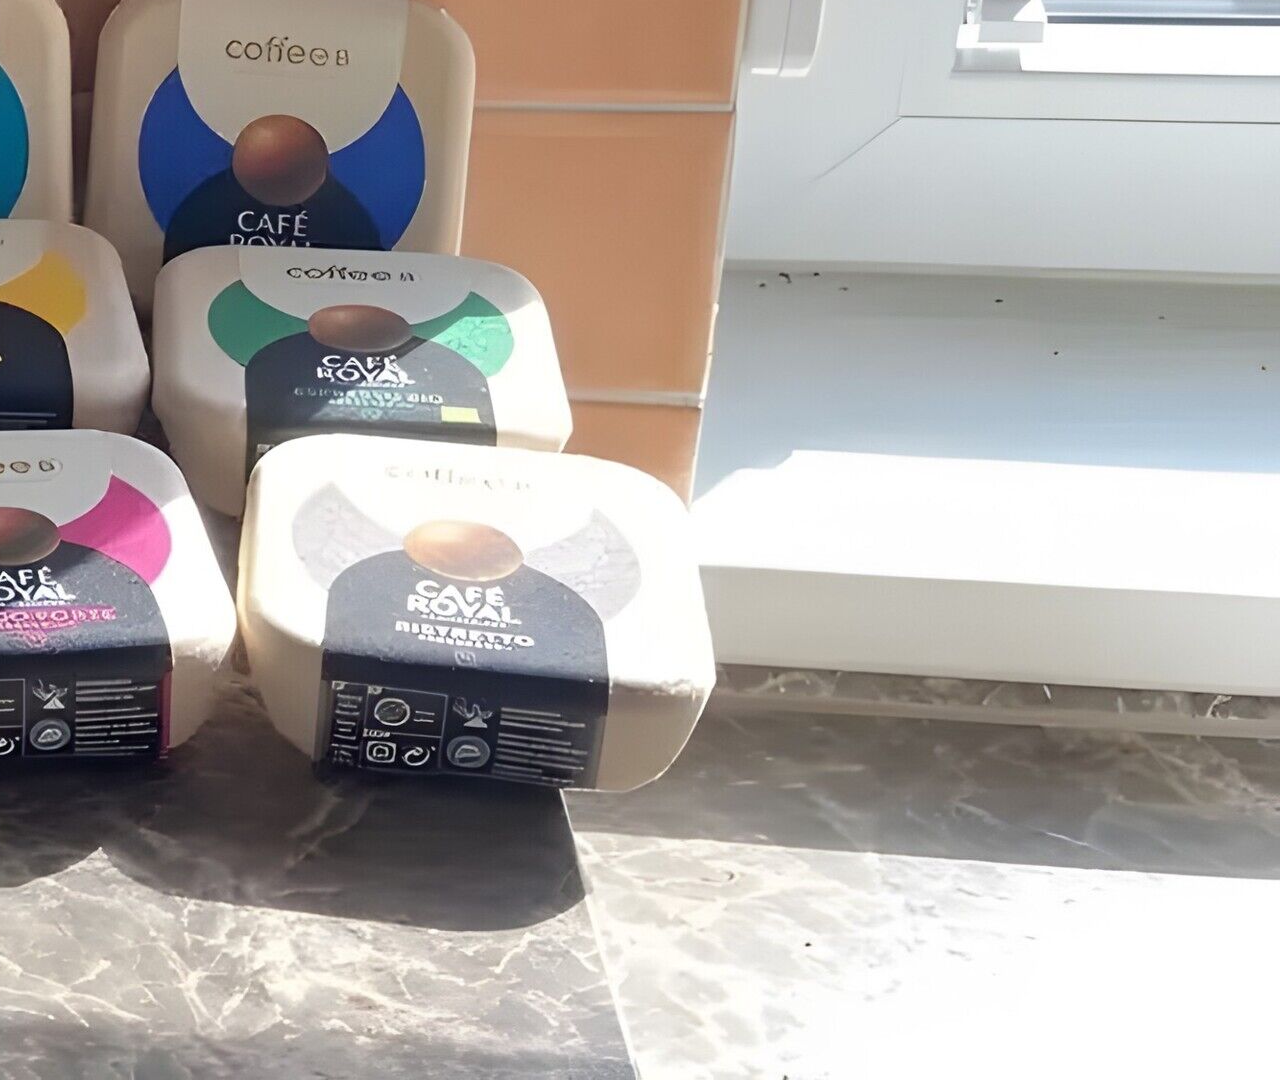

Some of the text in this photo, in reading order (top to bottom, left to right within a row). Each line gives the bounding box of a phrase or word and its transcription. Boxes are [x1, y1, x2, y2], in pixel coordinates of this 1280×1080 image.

[237, 210, 308, 237] CAFÉ
[415, 579, 505, 608] CAFÉ
[406, 594, 523, 625] ROYAL
